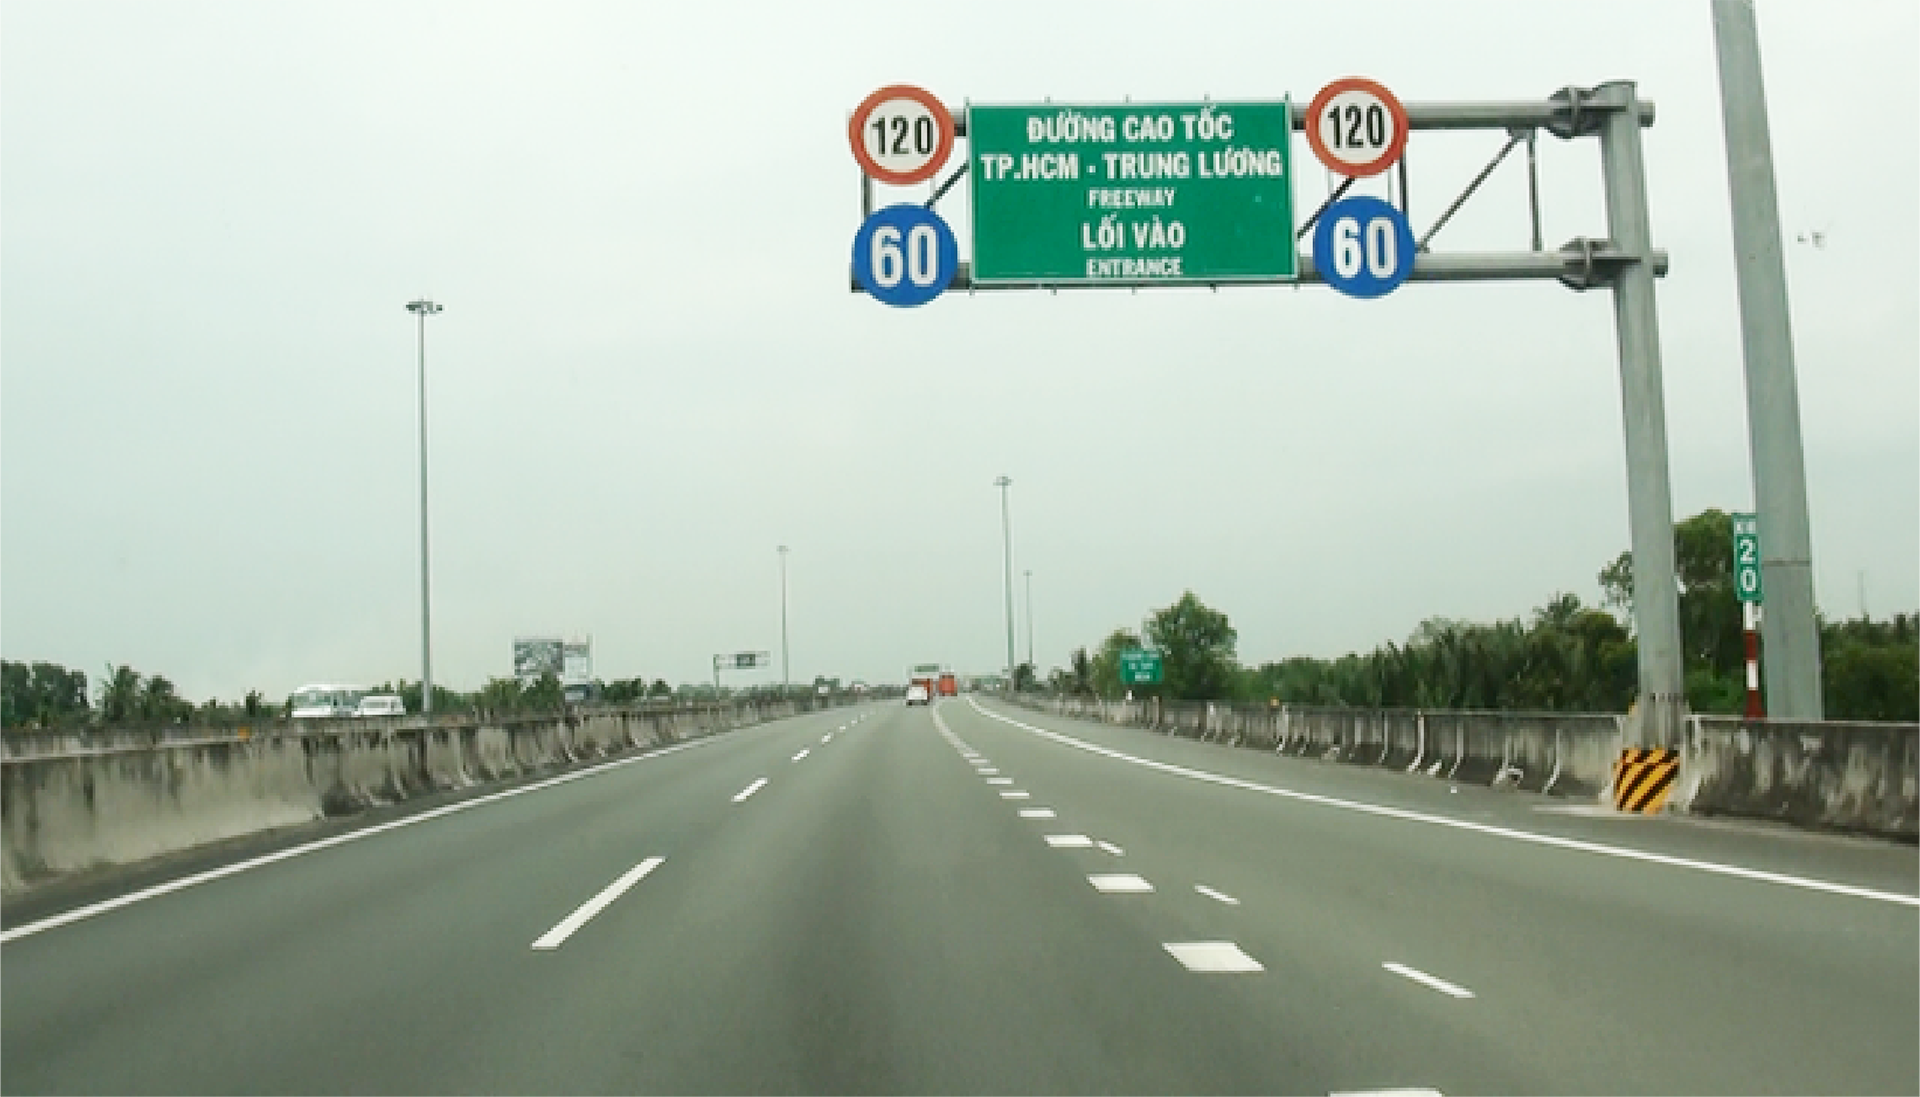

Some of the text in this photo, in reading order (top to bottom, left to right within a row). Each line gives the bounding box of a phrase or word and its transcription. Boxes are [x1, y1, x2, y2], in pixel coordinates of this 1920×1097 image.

[871, 115, 933, 157] 120
[1027, 104, 1234, 142] ĐƯỜNG CAO TỐC
[1328, 104, 1385, 148] 120
[981, 153, 1079, 180] TP.HCM
[1101, 152, 1190, 179] TRUNG
[1088, 187, 1176, 208] FREEWAY
[1082, 213, 1186, 250] LỐI VÀO
[1334, 217, 1397, 278] 60
[871, 225, 938, 287] 60
[1086, 258, 1183, 278] ENTRANCE
